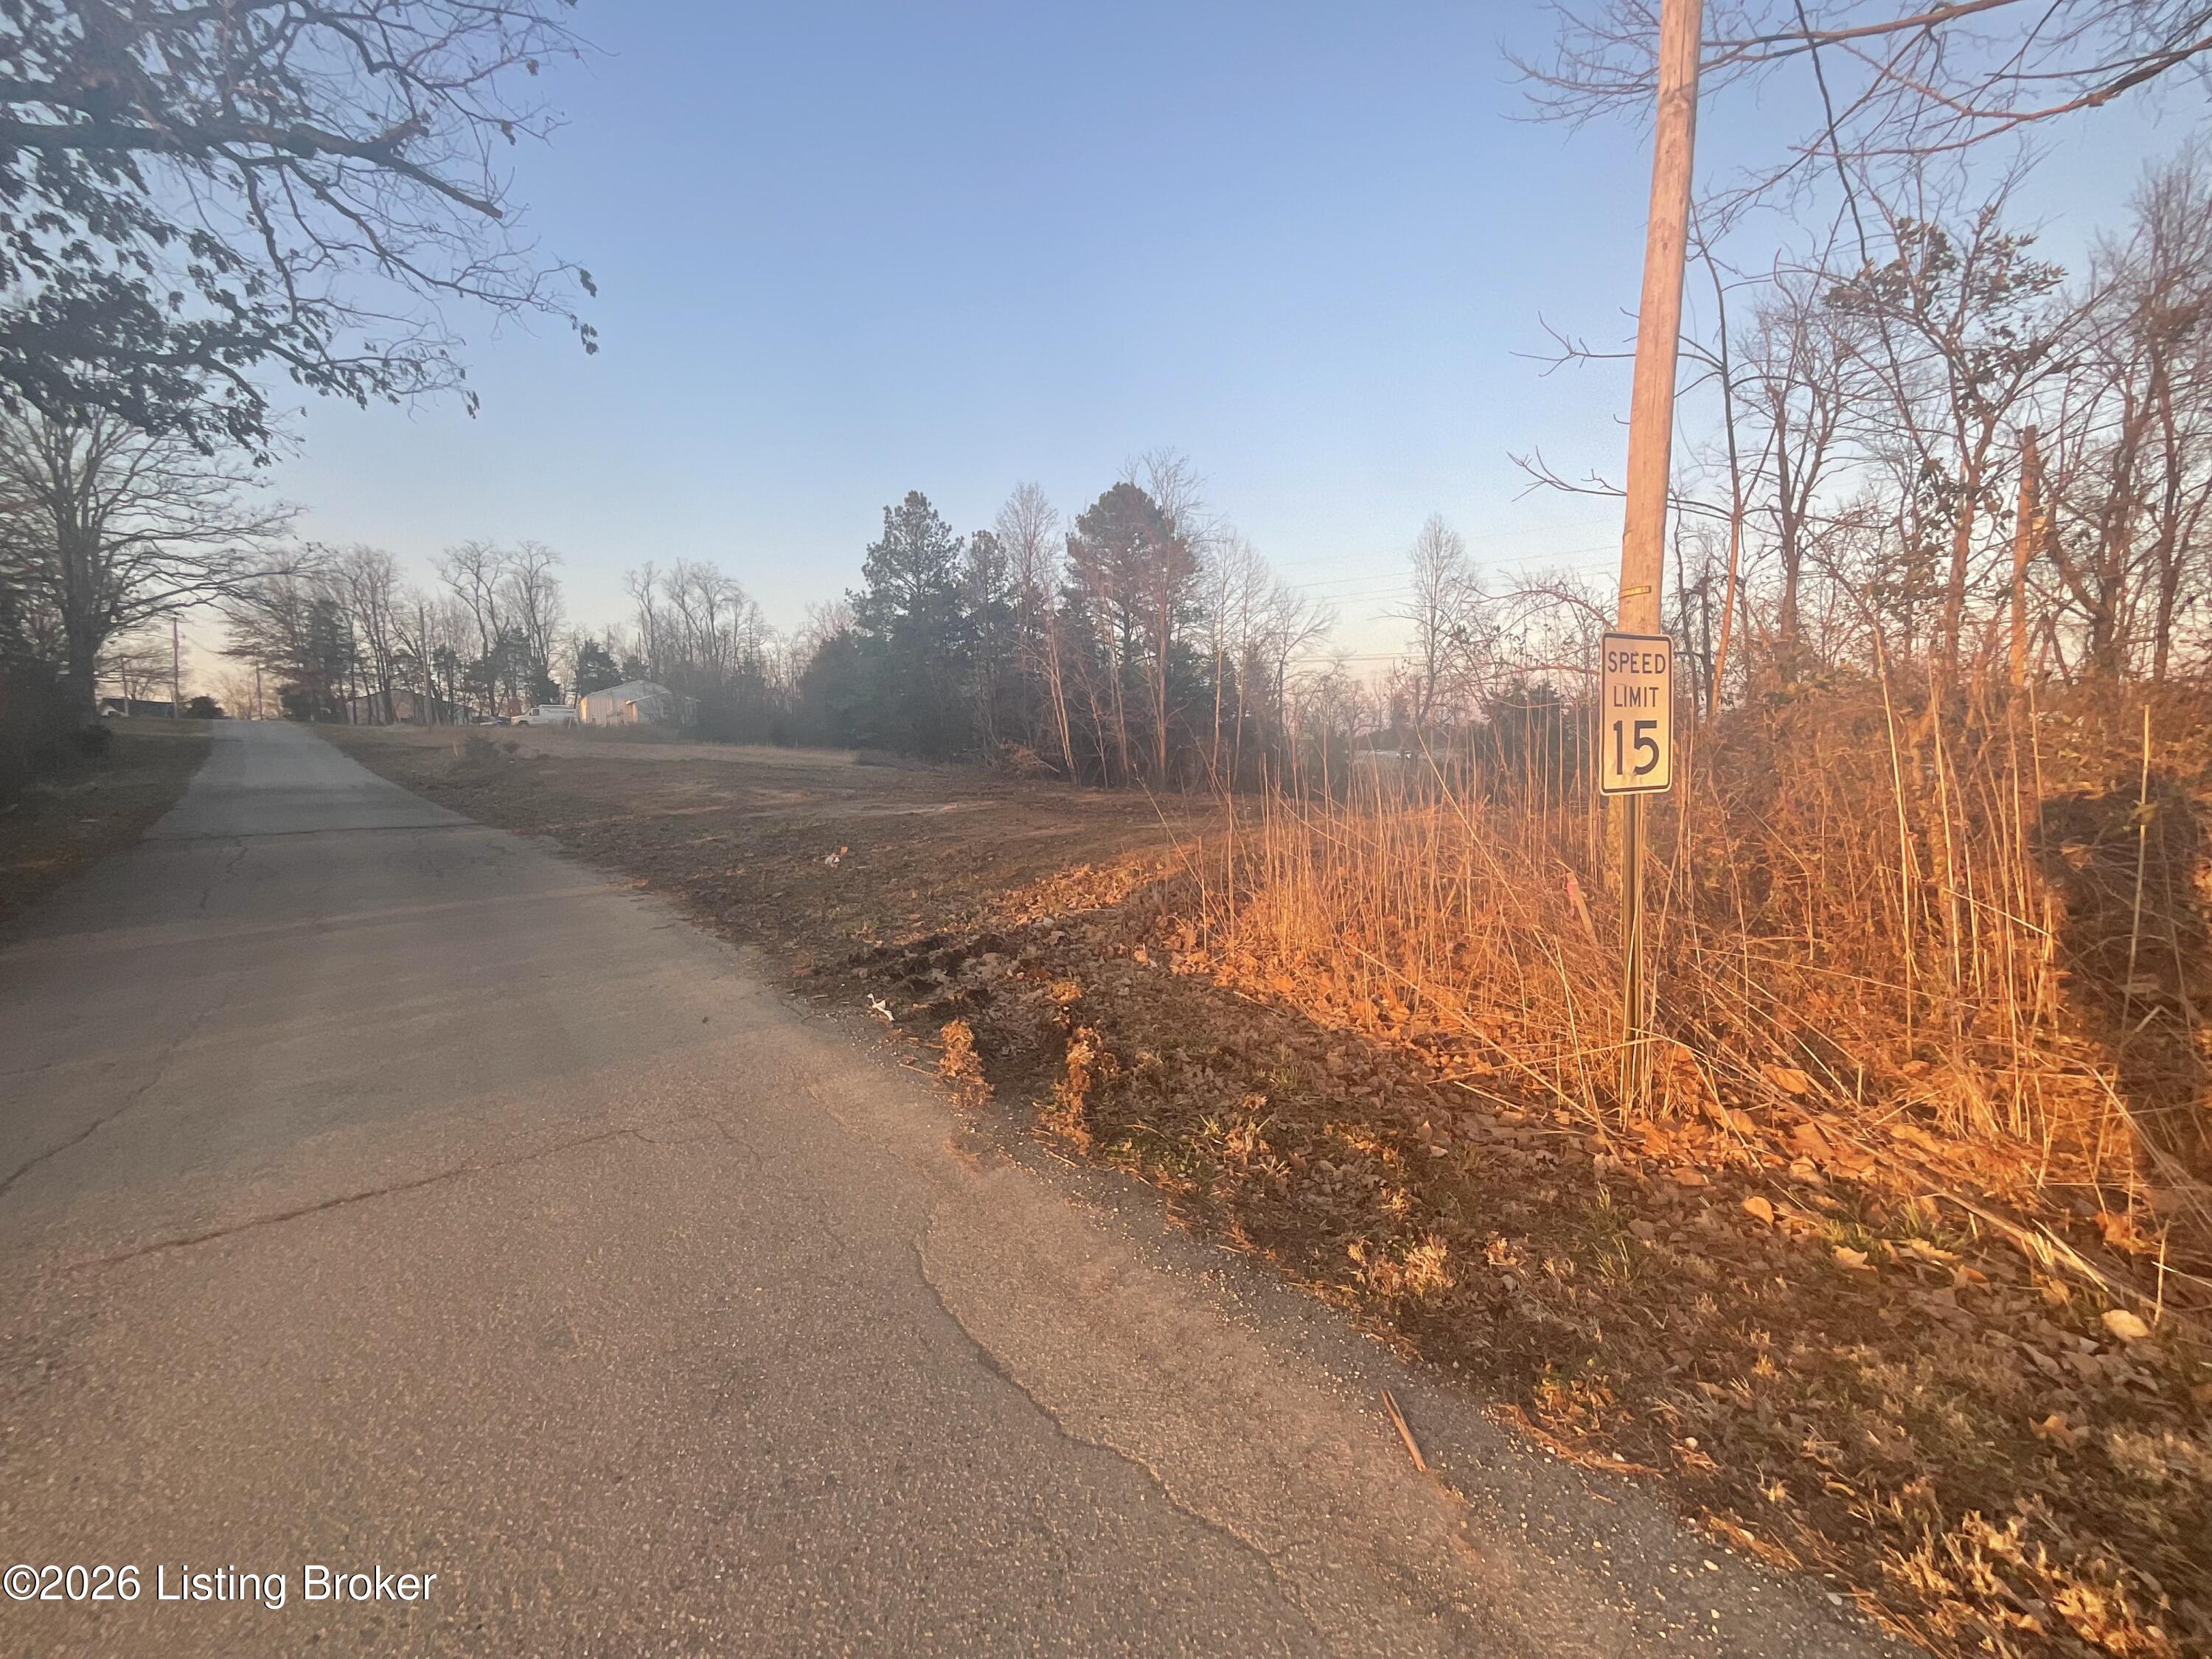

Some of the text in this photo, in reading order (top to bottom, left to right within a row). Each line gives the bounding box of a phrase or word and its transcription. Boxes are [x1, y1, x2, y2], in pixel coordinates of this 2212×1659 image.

[1607, 650, 1666, 674] SPEED
[1613, 686, 1659, 707] LIMIT
[1613, 720, 1660, 775] 15
